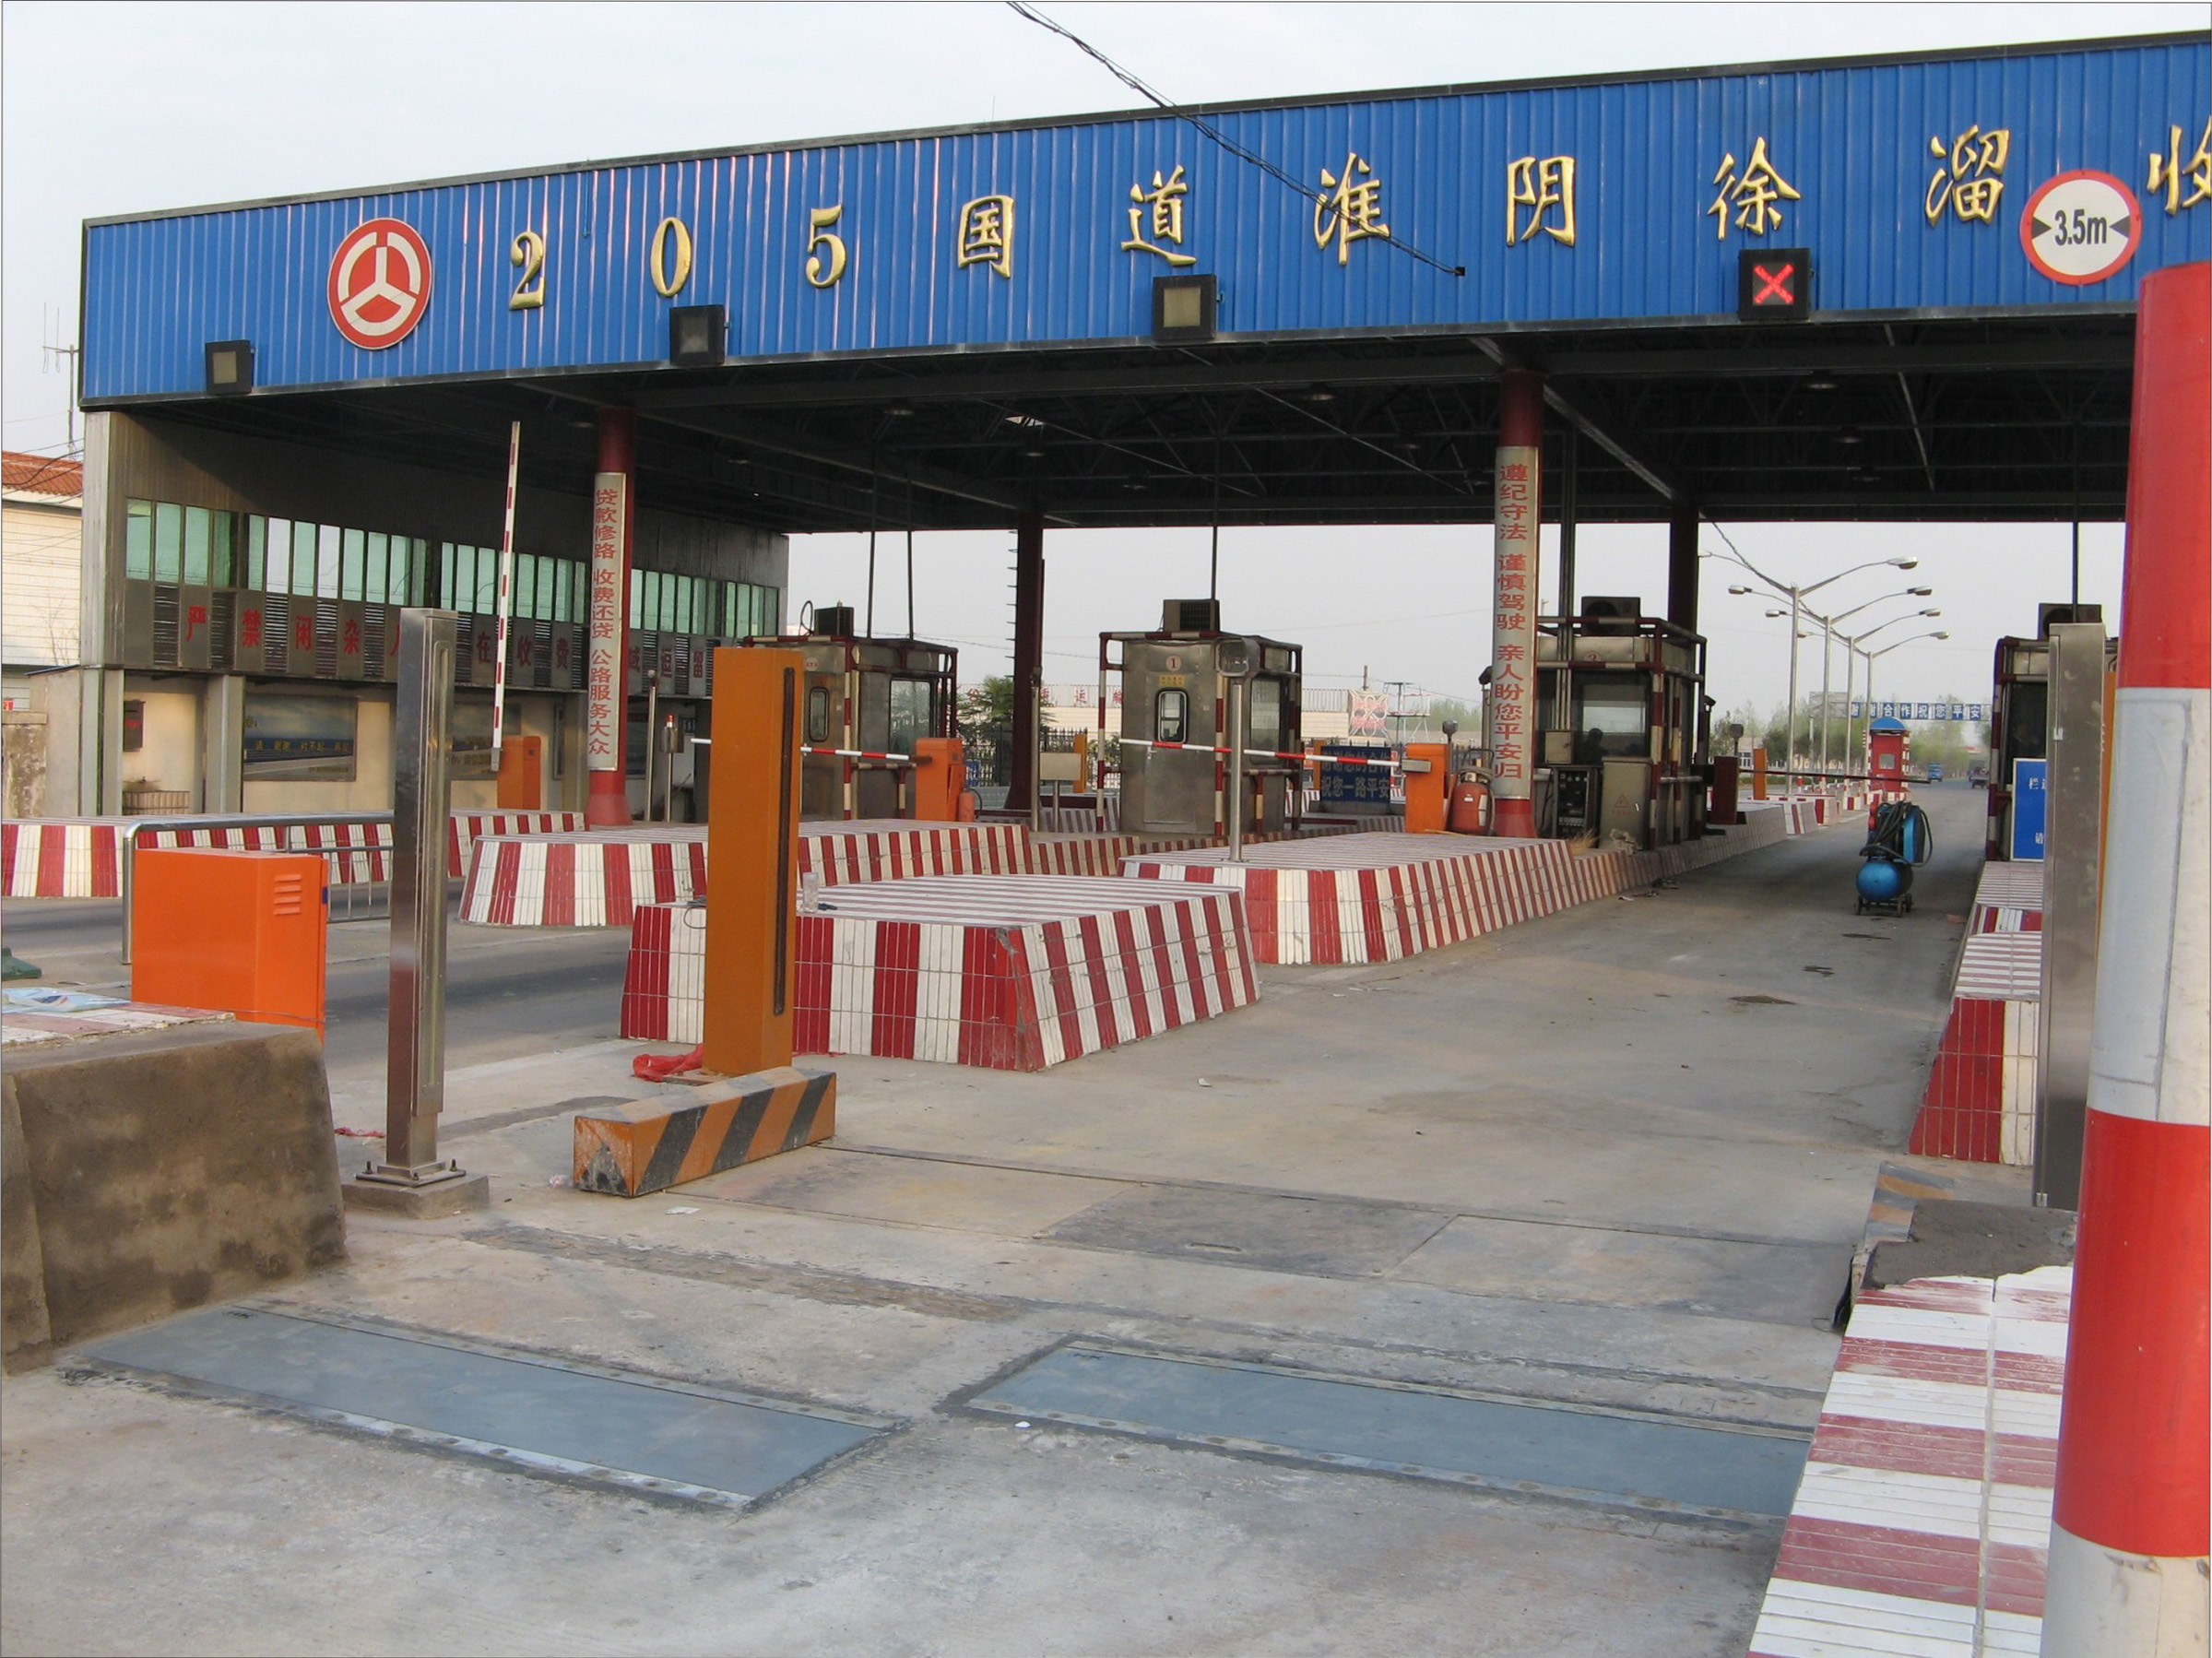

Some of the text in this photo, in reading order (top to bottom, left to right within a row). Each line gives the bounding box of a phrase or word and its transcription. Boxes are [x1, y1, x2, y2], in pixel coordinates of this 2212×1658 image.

[2054, 209, 2107, 246] 3.5m
[588, 489, 619, 755] 贷款修路 收费还贷 公路服务大众
[1494, 464, 1528, 779] 遵纪守法 谨慎驾驶 亲人盼您平安归
